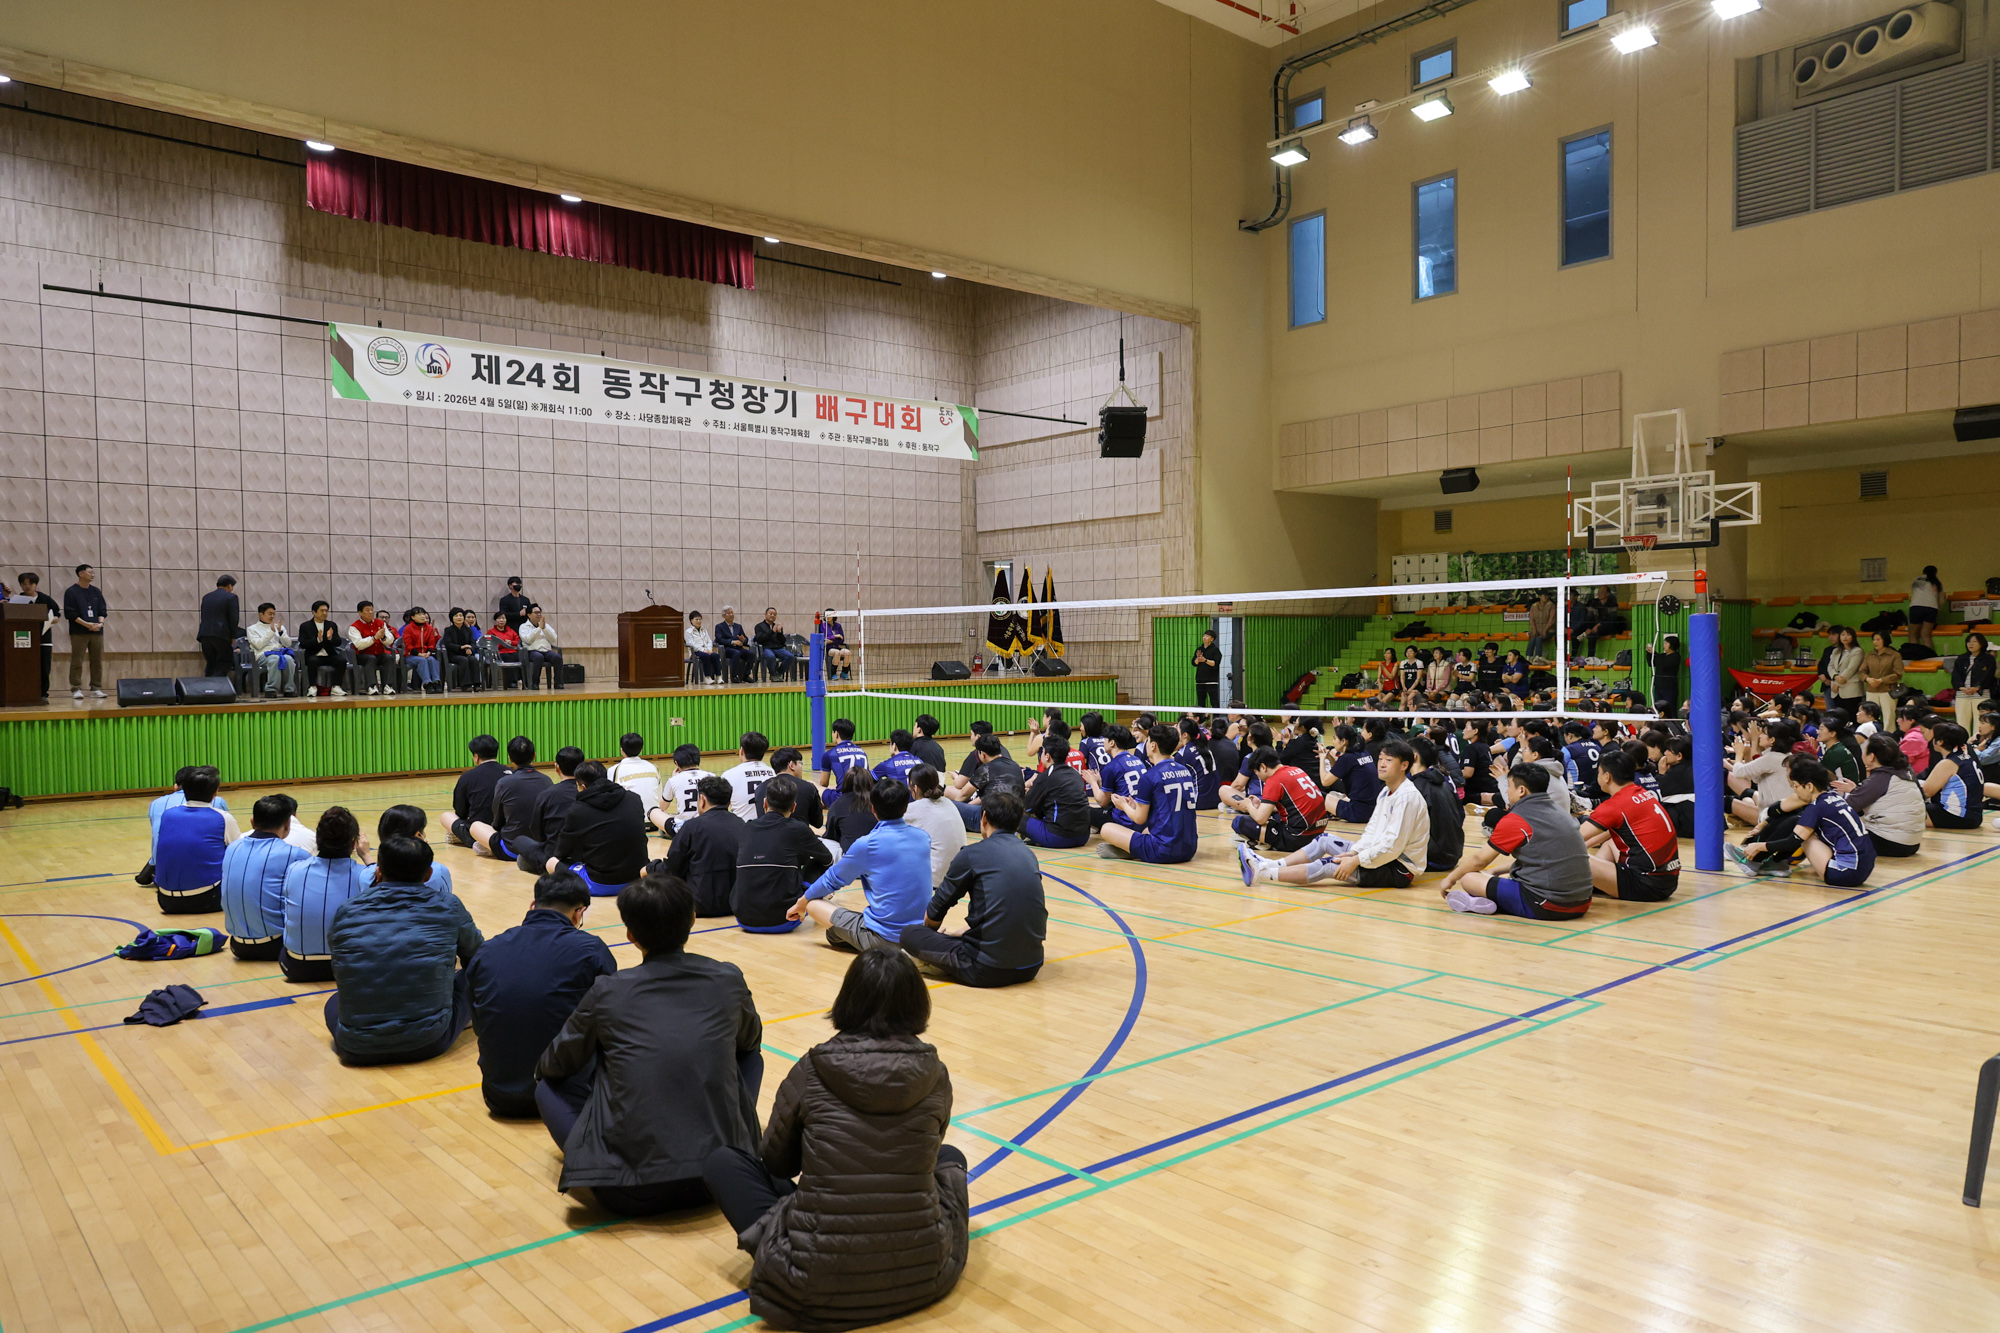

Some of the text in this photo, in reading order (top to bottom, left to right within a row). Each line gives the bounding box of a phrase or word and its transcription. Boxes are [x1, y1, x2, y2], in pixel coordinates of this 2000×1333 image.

[426, 365, 443, 375] DVA
[470, 353, 921, 432] 제24회 동작구청장기 배구대회
[416, 390, 434, 402] 일시
[444, 394, 477, 406] 2026년
[480, 397, 495, 407] 4월
[498, 398, 528, 411] 5일(일)
[568, 406, 592, 416] 11:00
[615, 410, 631, 420] 장소
[638, 412, 692, 426] 사당종합체육관
[712, 420, 726, 430] 주최
[733, 422, 768, 434] 서울특별시
[770, 426, 810, 438] 동작구체육회
[827, 432, 841, 442] 주관
[846, 434, 890, 446] 동작구배구협회
[905, 441, 917, 450] 후원
[922, 444, 940, 452] 동작구
[838, 754, 868, 771] 77
[1096, 746, 1112, 765] 8
[1162, 771, 1176, 780] JOO
[1164, 782, 1196, 812] 73
[1654, 804, 1672, 832] 1
